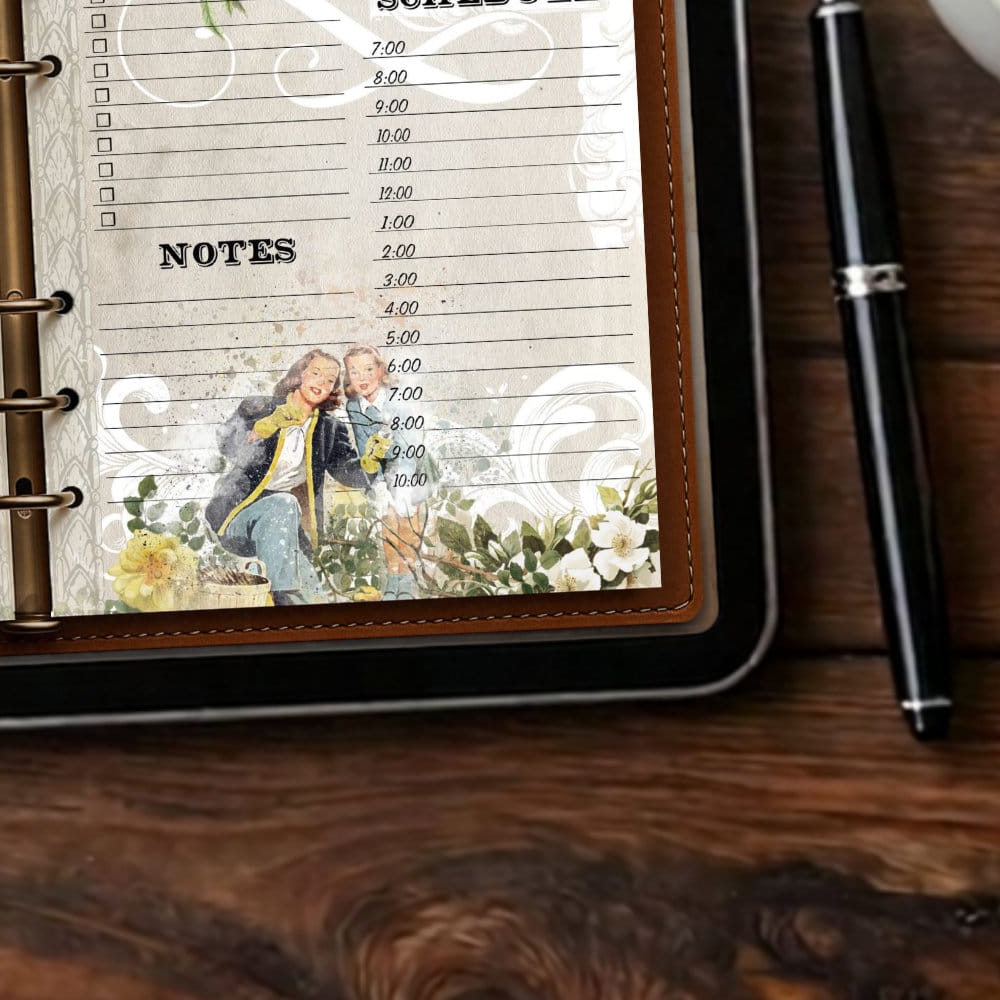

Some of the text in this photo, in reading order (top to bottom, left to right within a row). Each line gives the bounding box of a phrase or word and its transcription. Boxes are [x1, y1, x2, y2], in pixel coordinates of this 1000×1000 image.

[371, 40, 405, 56] 7:00
[373, 69, 408, 85] 8:00
[375, 98, 409, 113] 9:00
[376, 128, 411, 143] 10:00
[378, 156, 412, 171] 11:00
[379, 186, 413, 200] 12:00
[380, 215, 415, 230] 1:00
[159, 237, 297, 269] NOTES
[382, 244, 416, 258] 2:00
[383, 272, 417, 287] 3:00
[384, 301, 419, 316] 4:00
[386, 330, 420, 345] 5:00
[387, 358, 421, 373] 6:00
[388, 387, 423, 402] 7:00
[390, 415, 424, 430] 8:00
[391, 444, 425, 459] 9:00
[393, 473, 427, 488] 10:00
